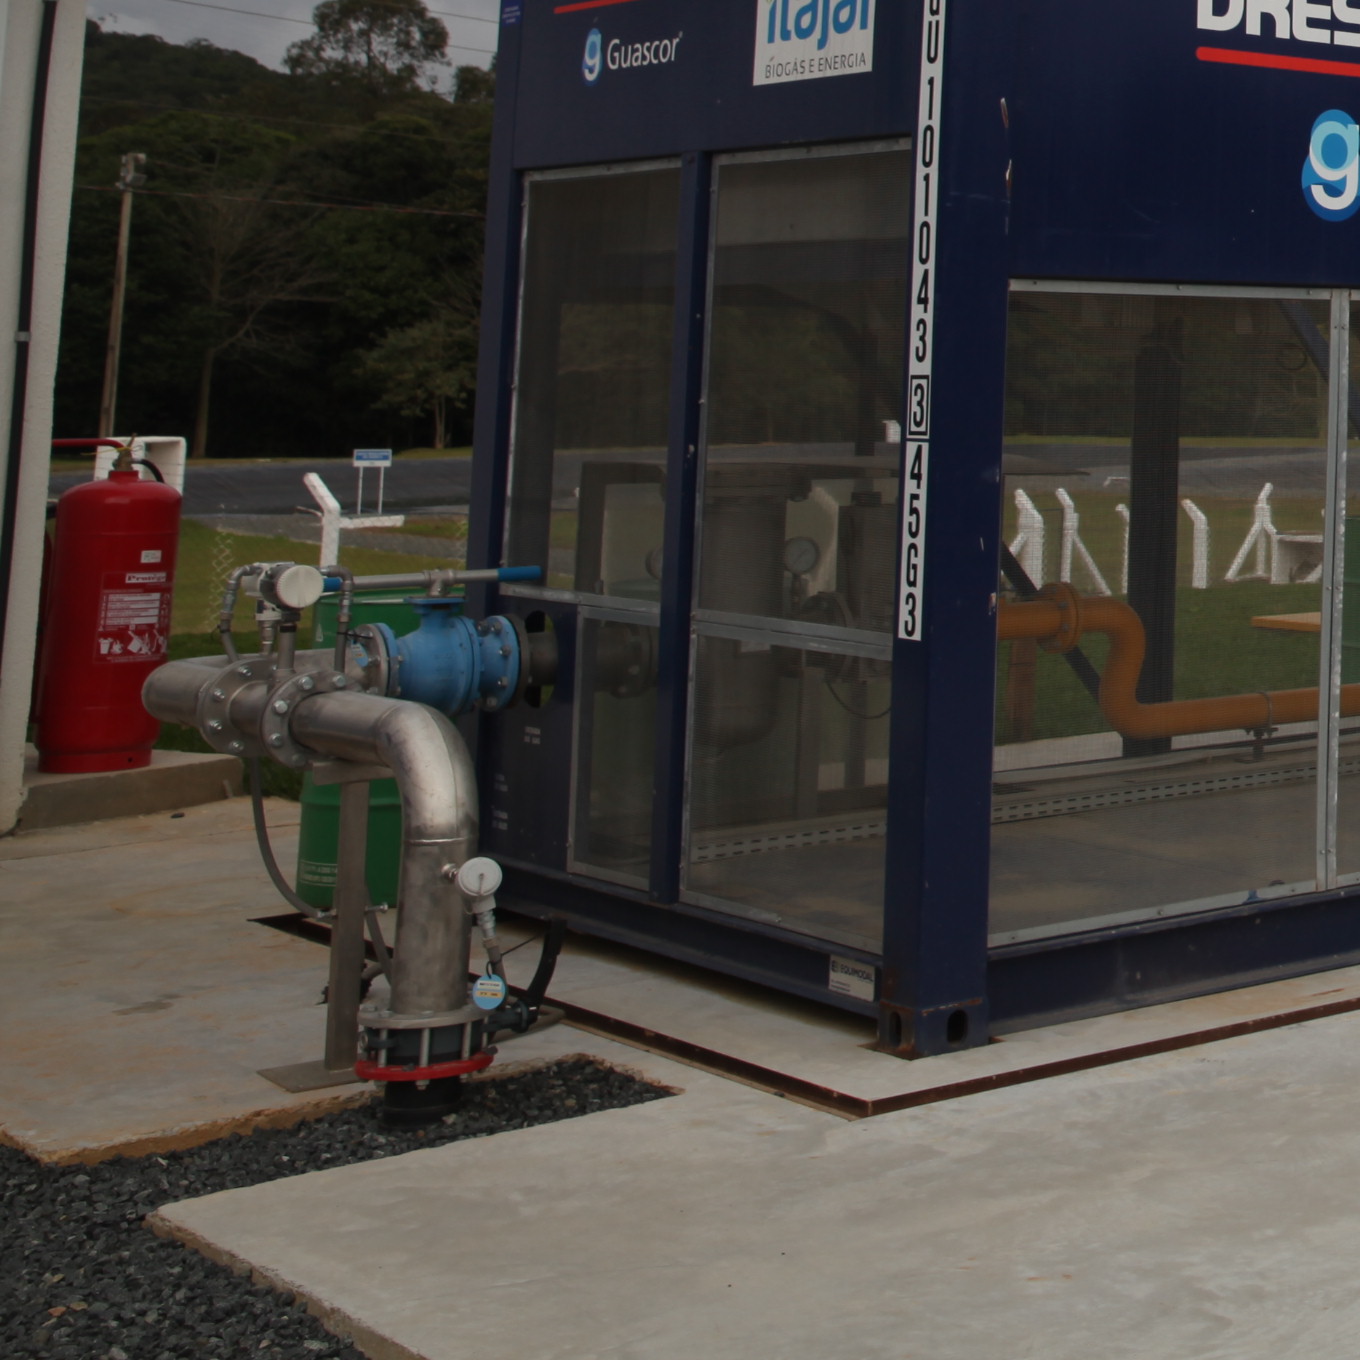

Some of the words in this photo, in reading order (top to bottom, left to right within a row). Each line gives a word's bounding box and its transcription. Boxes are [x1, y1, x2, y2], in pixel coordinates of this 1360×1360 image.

[808, 58, 815, 73] E
[818, 52, 867, 72] ENERGIA
[915, 76, 934, 363] 101043
[903, 444, 923, 637] 45G3
